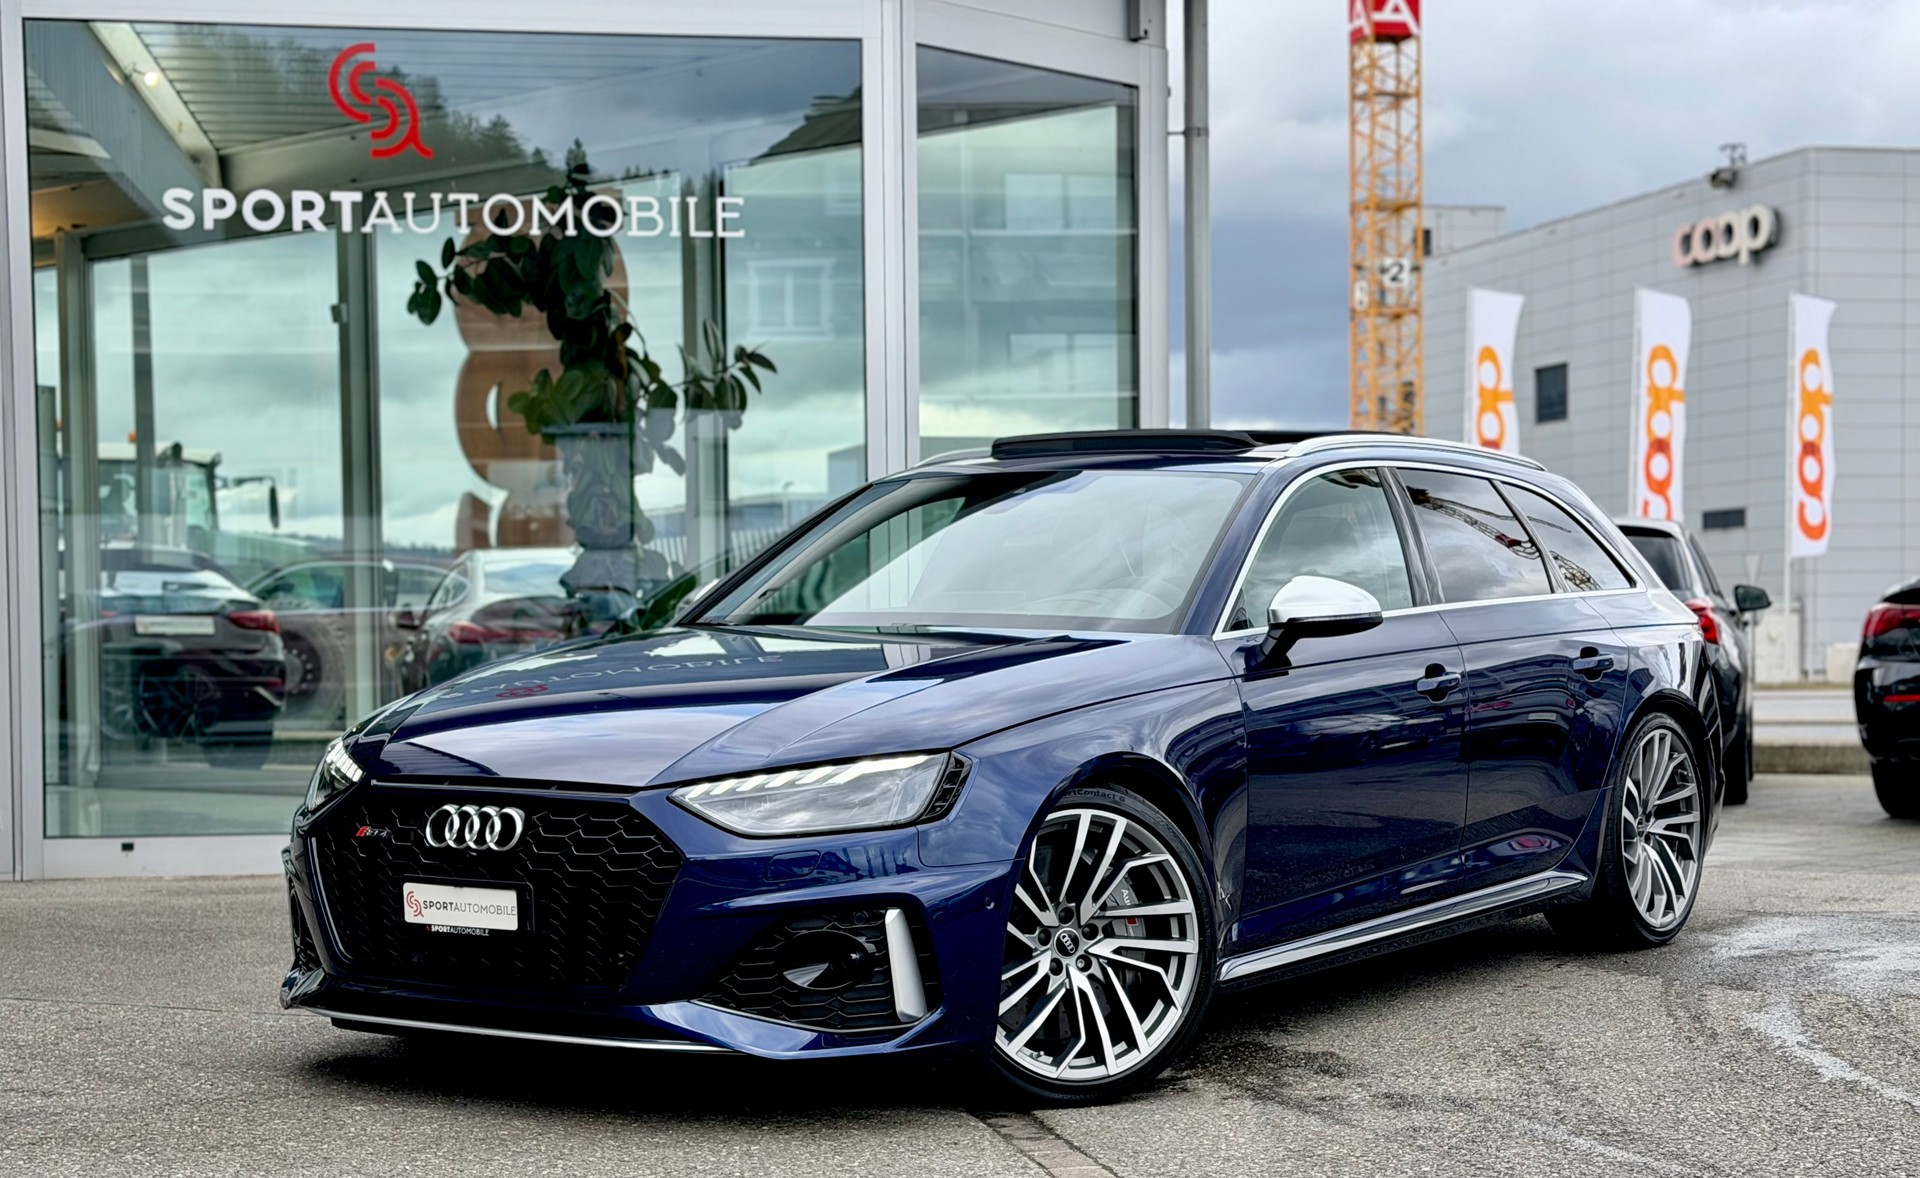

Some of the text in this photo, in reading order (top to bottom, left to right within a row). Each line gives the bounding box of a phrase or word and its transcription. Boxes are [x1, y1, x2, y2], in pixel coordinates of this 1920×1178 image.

[162, 187, 745, 238] SPORTAUTOMOBILE
[1670, 203, 1777, 267] coop
[1389, 262, 1405, 283] 2
[1476, 345, 1515, 449] op
[1798, 348, 1833, 541] coop
[422, 899, 517, 916] SPORTAUTOMOBILE
[430, 925, 490, 936] SPORTAUTOMOBILE
